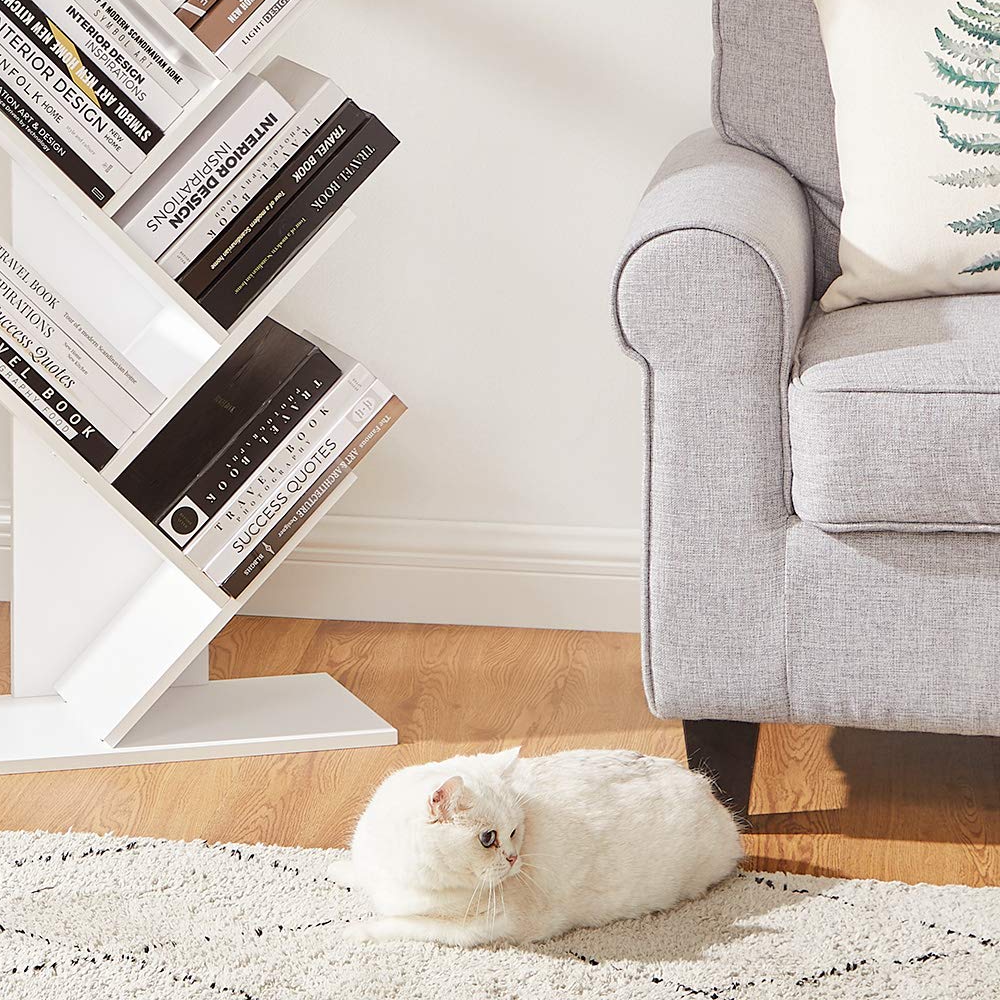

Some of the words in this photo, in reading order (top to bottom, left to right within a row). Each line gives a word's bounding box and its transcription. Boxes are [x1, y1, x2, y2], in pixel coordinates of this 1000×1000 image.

[29, 19, 54, 45] NEW
[226, 6, 244, 25] NEW
[242, 20, 265, 45] LIGHT
[48, 39, 81, 65] HOME
[66, 6, 111, 51] INTERIOR
[109, 48, 145, 85] DESIGN
[93, 9, 130, 48] SYMBOL
[133, 50, 153, 69] ART
[104, 5, 131, 31] MODERN
[128, 29, 167, 69] SCANDINAVIAN
[165, 66, 183, 85] HOME
[73, 63, 100, 89] NEW
[85, 40, 146, 101] INSPIRATIONS
[41, 101, 64, 124] HOME
[53, 78, 108, 133] DESIGN
[94, 83, 118, 108] ART
[5, 105, 20, 122] Driven
[25, 125, 50, 152] Technology
[16, 107, 34, 124] ART
[38, 128, 66, 156] DESIGN
[109, 128, 124, 142] NEW
[111, 101, 154, 142] SYMBOL
[104, 134, 122, 152] HOME
[216, 113, 278, 177] INTERIOR
[241, 126, 301, 189] PHOTOGRAPHY
[260, 118, 322, 180] TRAVEL
[314, 125, 346, 157] TRAVEL
[290, 154, 318, 183] BOOK
[337, 145, 375, 181] TRAVEL
[147, 142, 231, 232] INSPIRATIONS
[169, 176, 219, 229] DESIGN
[215, 194, 237, 218] FOOD
[272, 189, 286, 203] Tour
[311, 181, 341, 211] BOOK
[207, 193, 251, 238] BOOK
[248, 208, 268, 229] modern
[223, 226, 251, 257] Scandinavian
[209, 254, 225, 271] home
[29, 280, 60, 309] BOOK
[63, 312, 74, 324] Tour
[81, 330, 99, 348] modern
[98, 345, 125, 373] Scandinavian
[124, 370, 137, 384] home
[29, 347, 75, 388] Quotes
[42, 388, 95, 438] BOOK
[42, 406, 70, 433] FOOD
[226, 388, 305, 467] PHOTOGRAPHY
[255, 380, 323, 444] TRAVEL
[377, 414, 392, 427] The
[359, 425, 381, 448] Famous
[214, 466, 282, 531] TRAVEL
[286, 407, 329, 453] BOOK
[343, 447, 360, 465] ART
[206, 456, 250, 503] BOOK
[230, 441, 310, 522] PHOTOGRAPHY
[233, 493, 288, 553] SUCCESS
[287, 439, 336, 493] QUOTES
[296, 466, 343, 517] ARCHITECTURE
[278, 516, 298, 537] Designer
